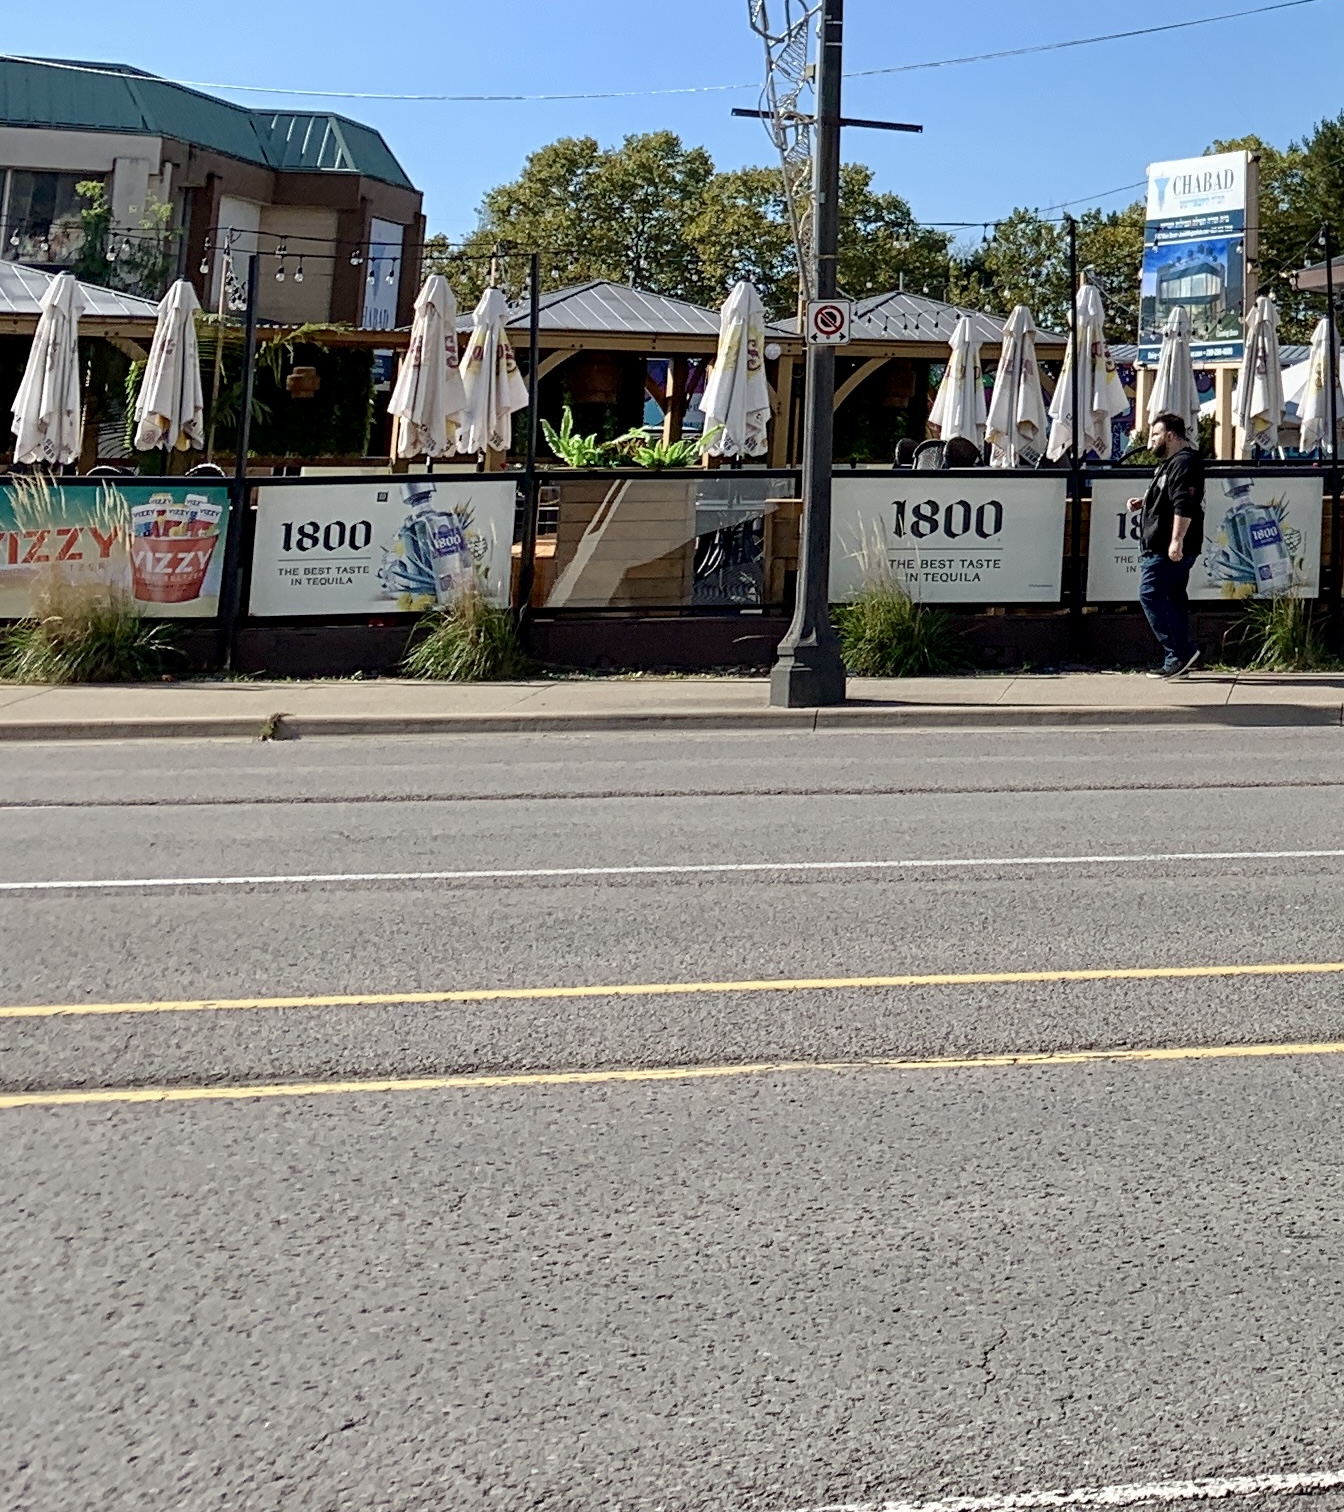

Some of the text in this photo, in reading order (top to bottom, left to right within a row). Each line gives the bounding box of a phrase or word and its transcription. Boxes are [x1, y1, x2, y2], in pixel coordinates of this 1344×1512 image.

[1173, 168, 1234, 196] CHABAD
[133, 509, 155, 518] VIZZY
[168, 508, 190, 516] VIZZY
[200, 508, 220, 517] VIZZY
[891, 499, 1004, 539] 1800
[281, 520, 372, 552] 1800
[1253, 527, 1278, 540] 1800
[434, 534, 461, 549] 1800
[132, 549, 213, 574] VIZZY
[889, 559, 1001, 569] THE BEST TASTE
[1114, 556, 1136, 564] THE
[278, 565, 370, 577] THE BEST TASTE
[290, 577, 353, 586] IN TEQUILA
[905, 573, 981, 582] IN TEQUILA
